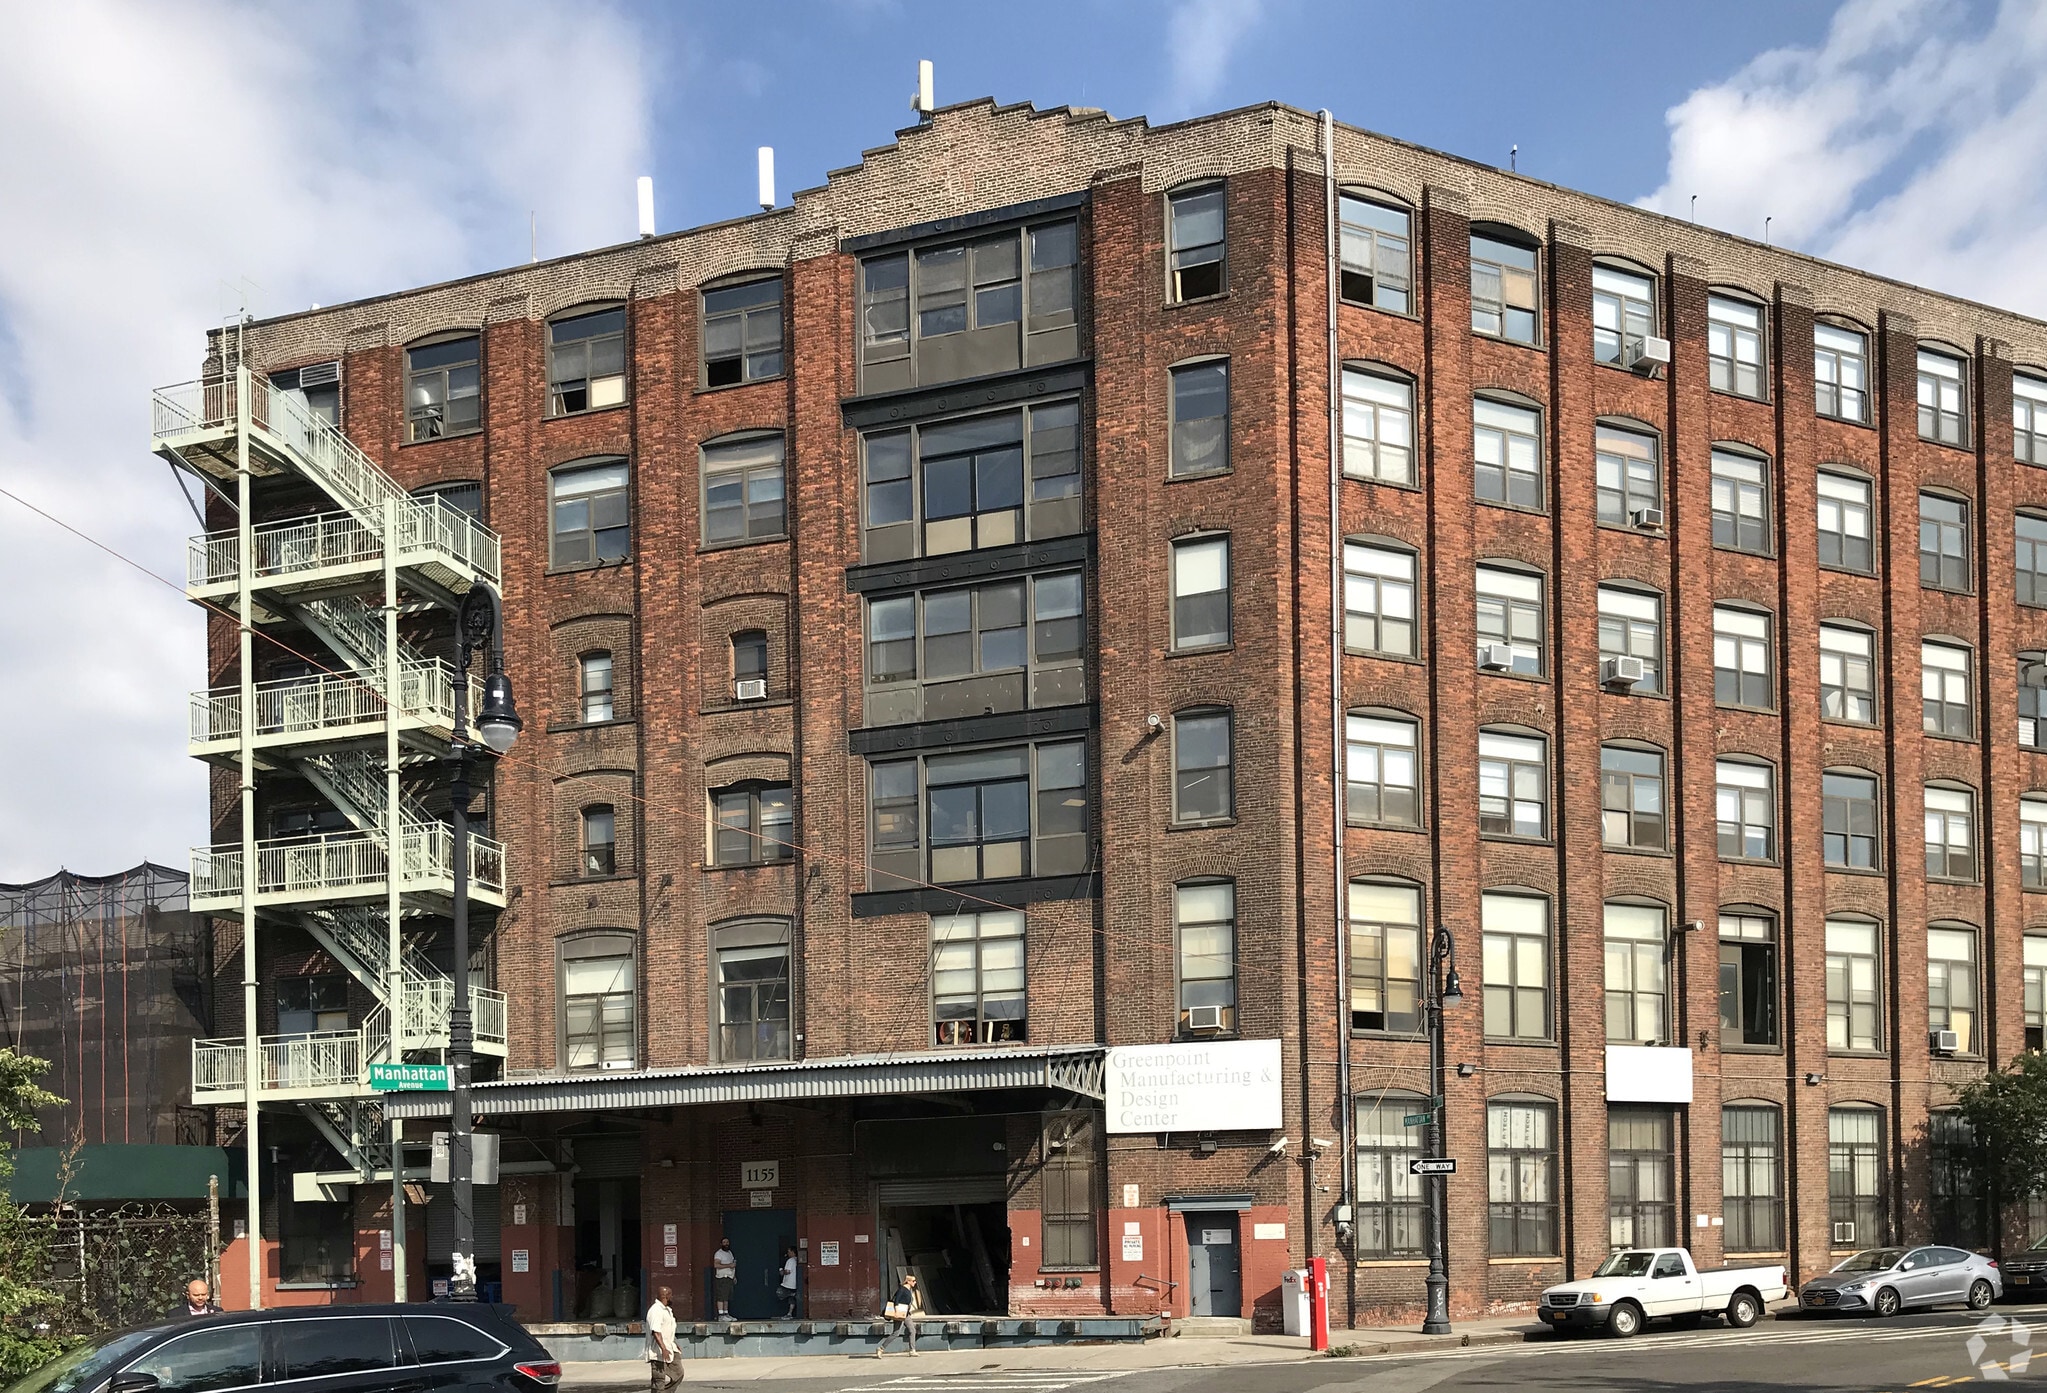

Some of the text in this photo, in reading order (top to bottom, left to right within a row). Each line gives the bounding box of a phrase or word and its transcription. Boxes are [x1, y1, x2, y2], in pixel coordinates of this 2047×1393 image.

[1112, 1050, 1211, 1069] Greenpoint
[374, 1066, 446, 1081] Manhattan
[1120, 1066, 1273, 1088] Manufacturing &
[398, 1081, 424, 1089] Avenue
[1121, 1090, 1179, 1109] Design
[1120, 1110, 1178, 1127] Center
[746, 1168, 775, 1182] 1155
[1284, 1276, 1296, 1284] FedEx
